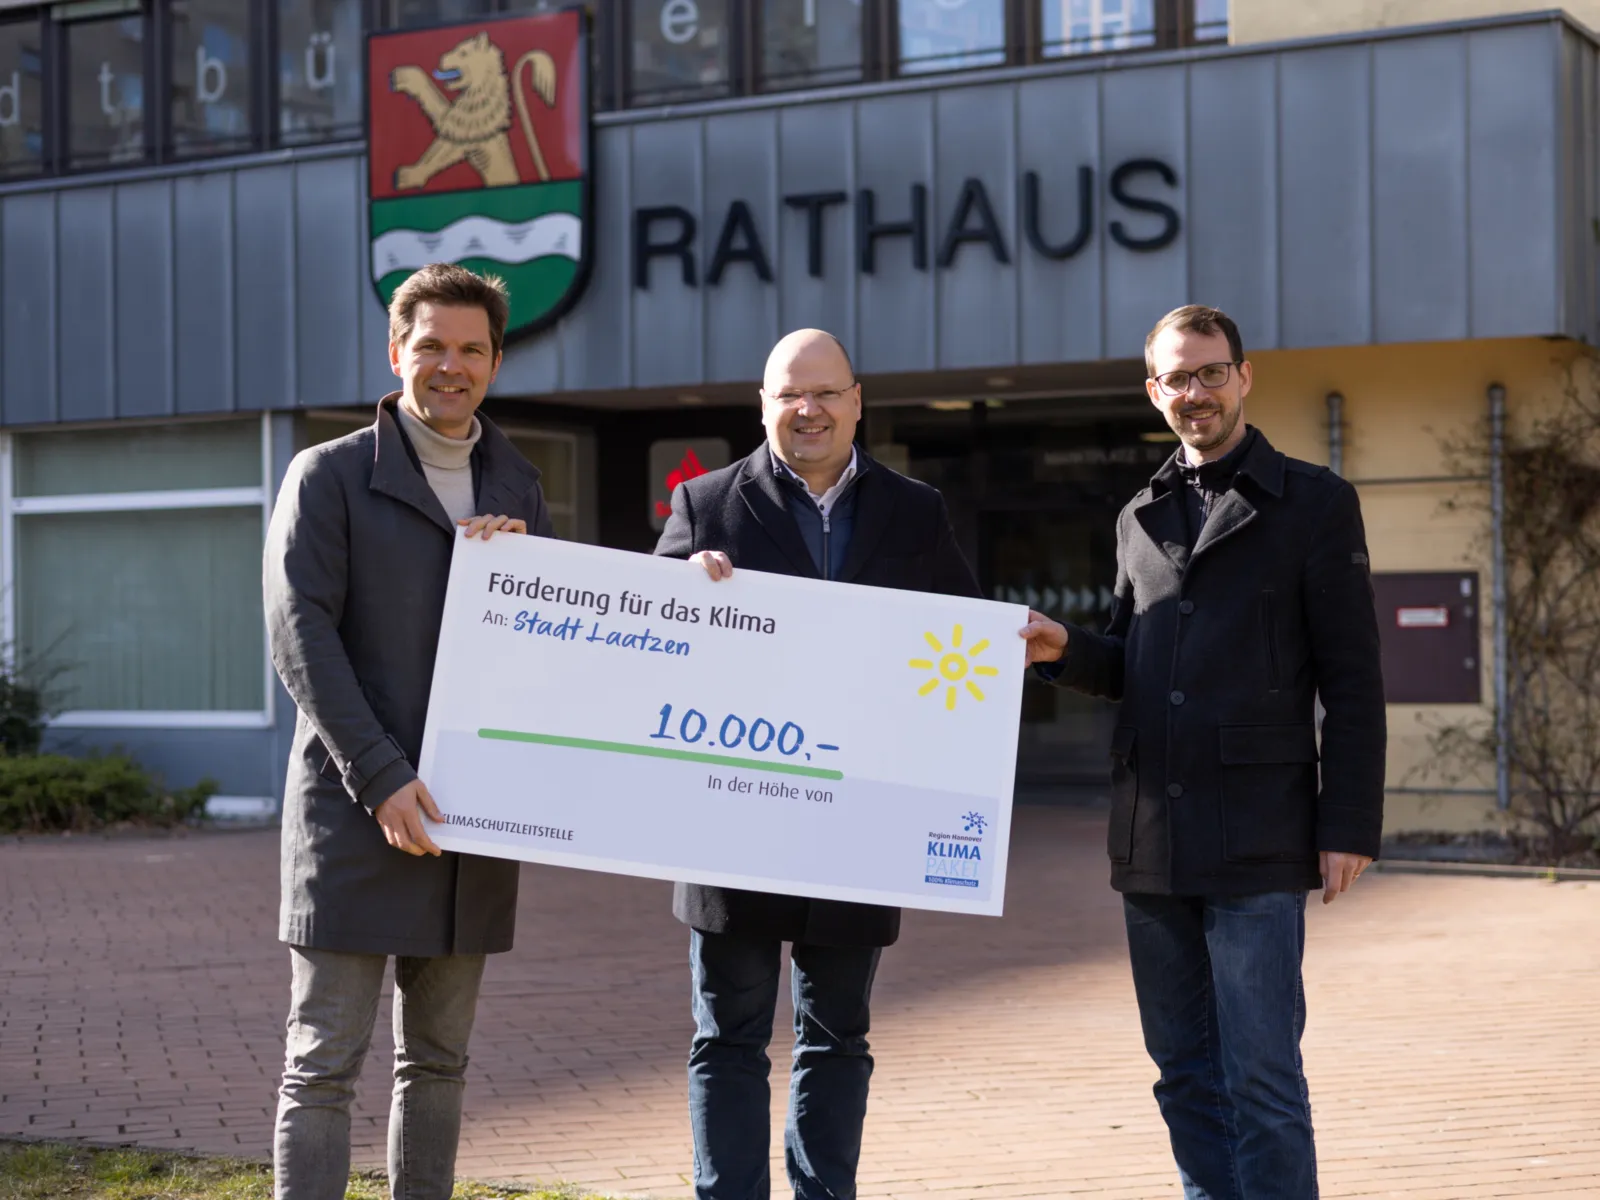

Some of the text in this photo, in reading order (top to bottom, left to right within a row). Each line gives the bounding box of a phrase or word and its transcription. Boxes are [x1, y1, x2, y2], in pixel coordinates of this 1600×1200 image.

[633, 156, 1182, 290] RATHAUS
[488, 572, 776, 634] Förderung für das Klima
[482, 609, 690, 656] An: Stadt Laatzen
[708, 775, 833, 803] In der Höhe von
[927, 841, 981, 860] KLIMA
[928, 832, 982, 843] Region Hannover
[926, 858, 980, 878] PAKET
